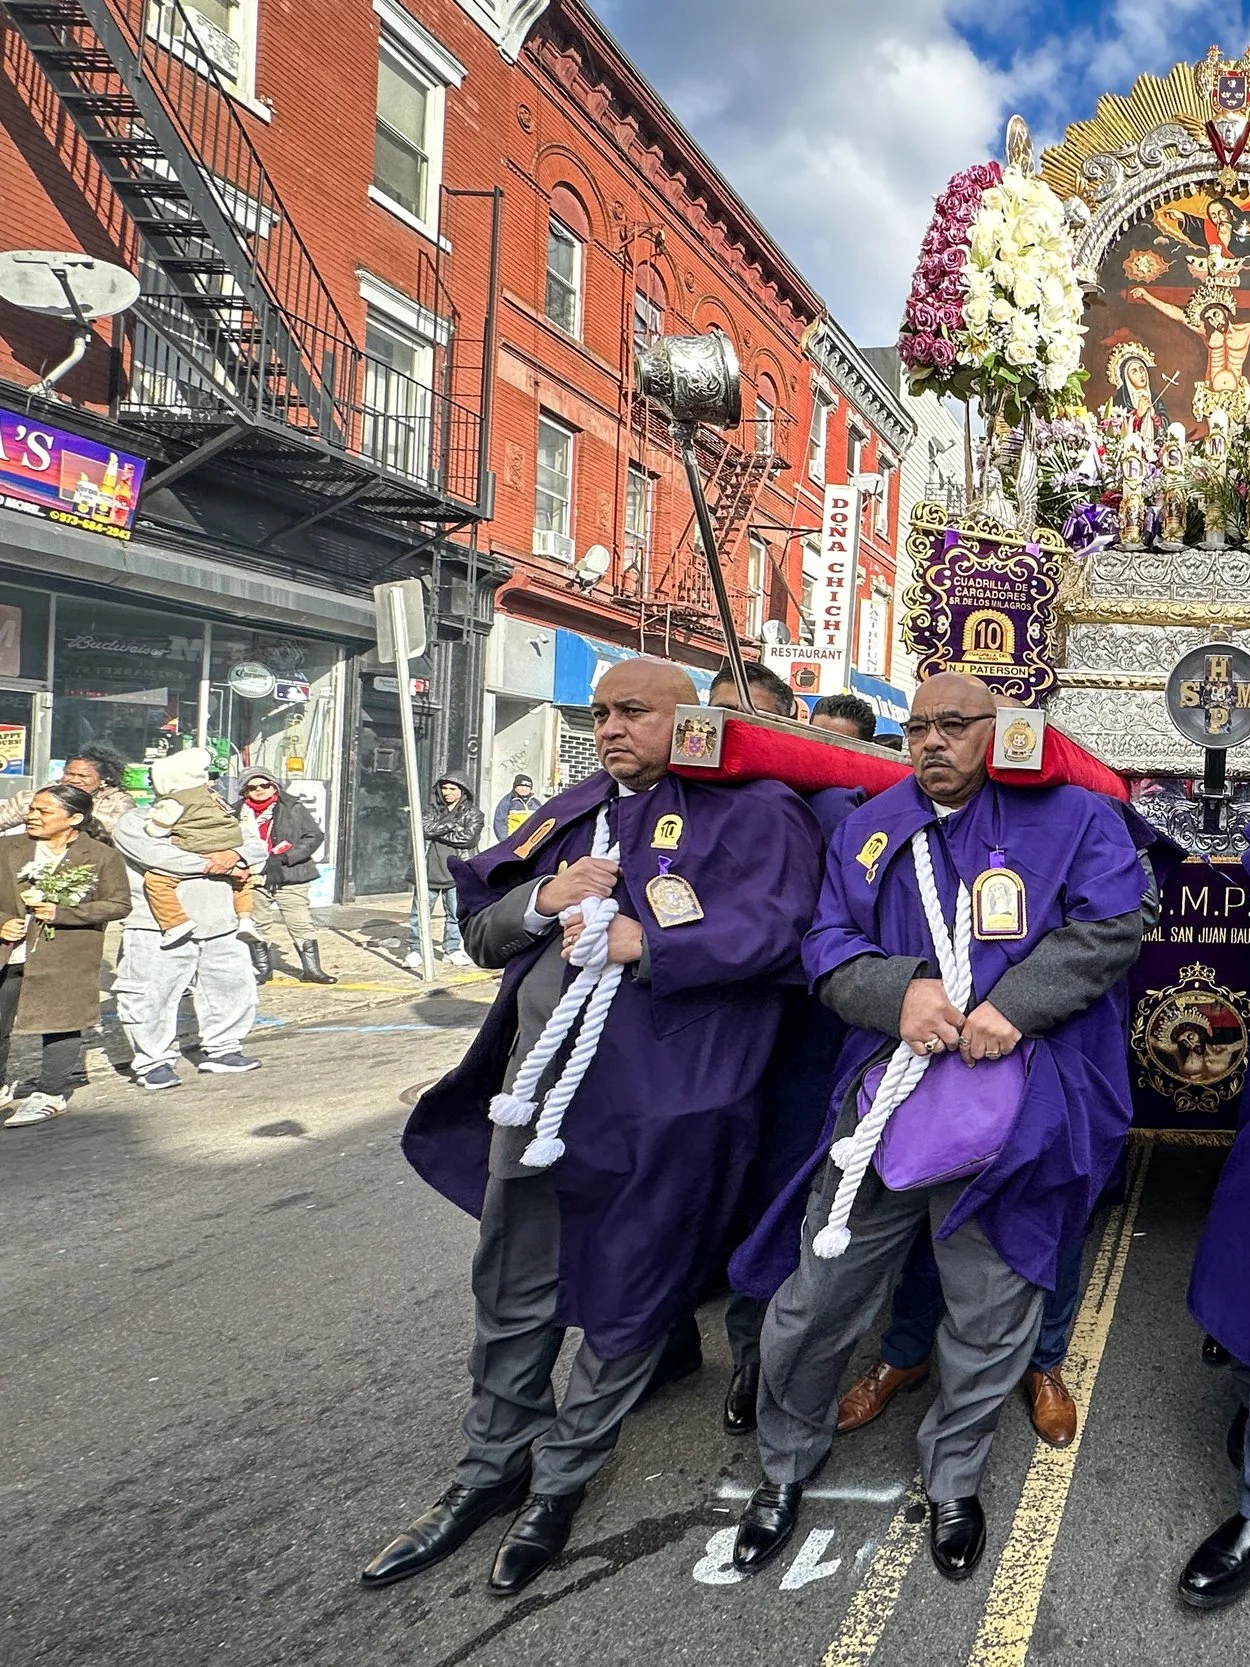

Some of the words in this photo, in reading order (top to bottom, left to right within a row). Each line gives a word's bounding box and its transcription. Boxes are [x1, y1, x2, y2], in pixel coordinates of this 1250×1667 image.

[828, 498, 849, 552] DOÑA
[953, 576, 1011, 591] CUADRILLA
[1015, 583, 1028, 592] DE
[954, 586, 1027, 602] CARGADORES
[822, 562, 845, 645] CHICHI
[948, 596, 961, 605] SR.
[962, 598, 973, 606] DE
[973, 598, 990, 607] LOS
[991, 600, 1032, 611] MILAGROS
[977, 621, 1002, 649] 10
[64, 635, 171, 656] Budweiser
[770, 647, 843, 661] RESTAURANT
[969, 665, 1026, 676] PATERSON
[1170, 926, 1193, 943] SAN
[1198, 927, 1227, 944] JUAN
